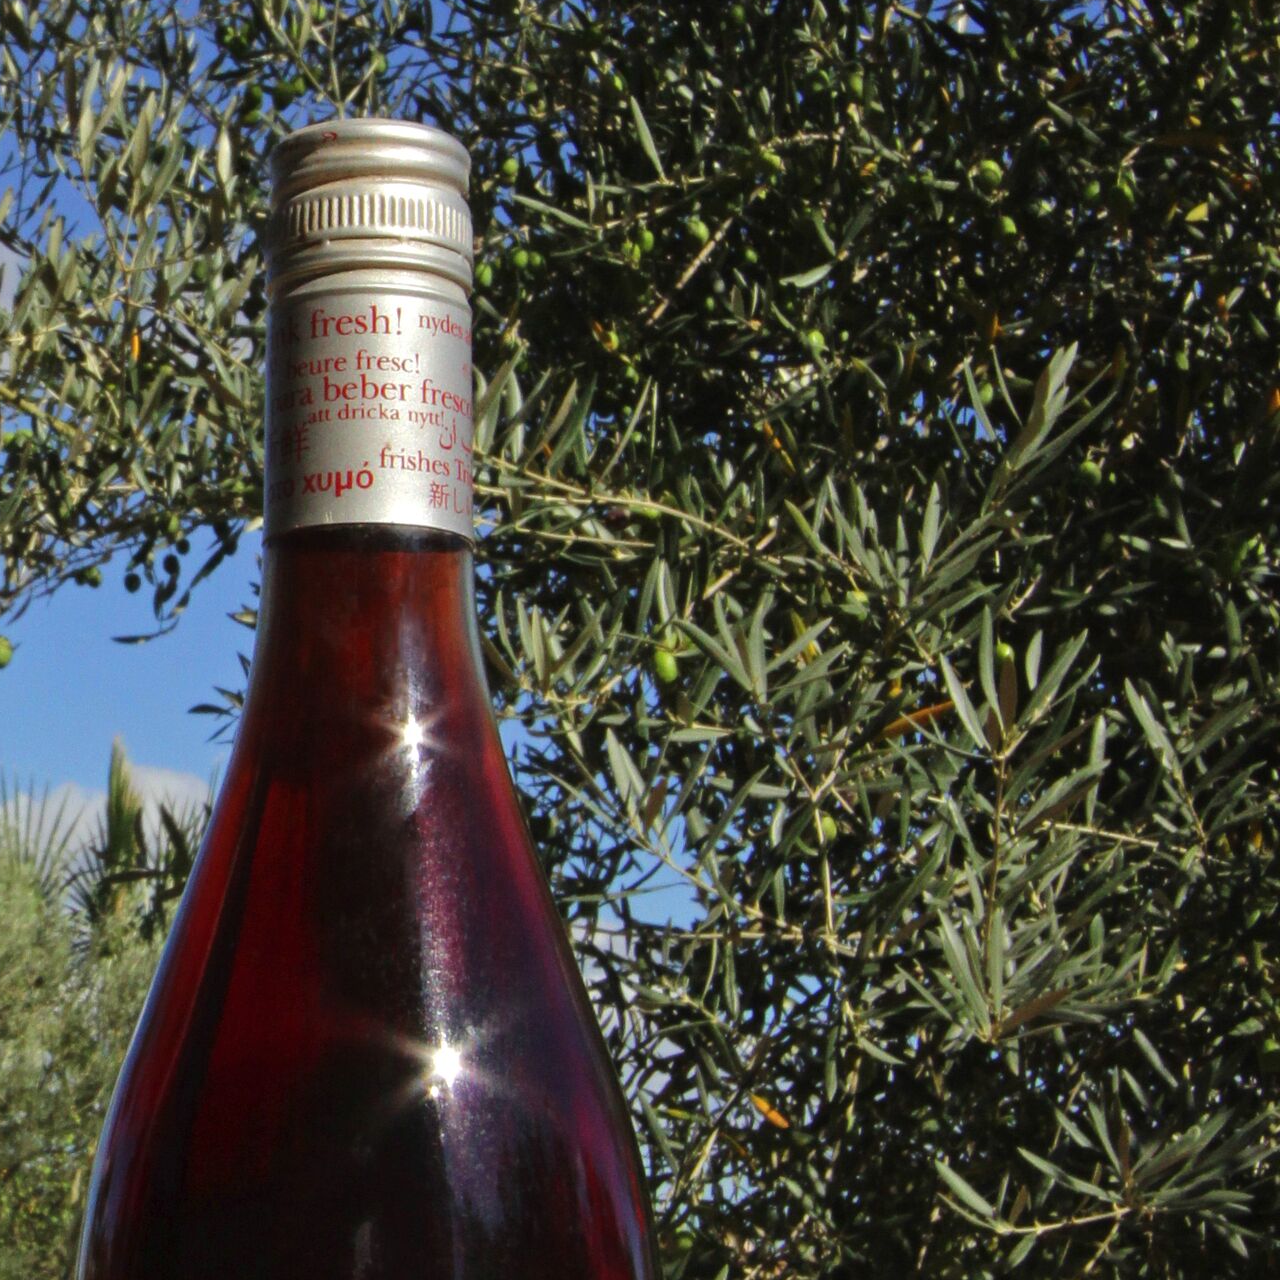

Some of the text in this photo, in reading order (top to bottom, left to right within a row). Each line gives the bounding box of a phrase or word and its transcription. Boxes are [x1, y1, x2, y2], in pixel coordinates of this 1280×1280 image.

[311, 304, 402, 338] fresh!
[419, 314, 463, 339] nydes
[355, 349, 420, 373] fresc!
[322, 374, 412, 402] beber
[308, 403, 446, 429] att dricka nytt!
[379, 447, 450, 477] frishes
